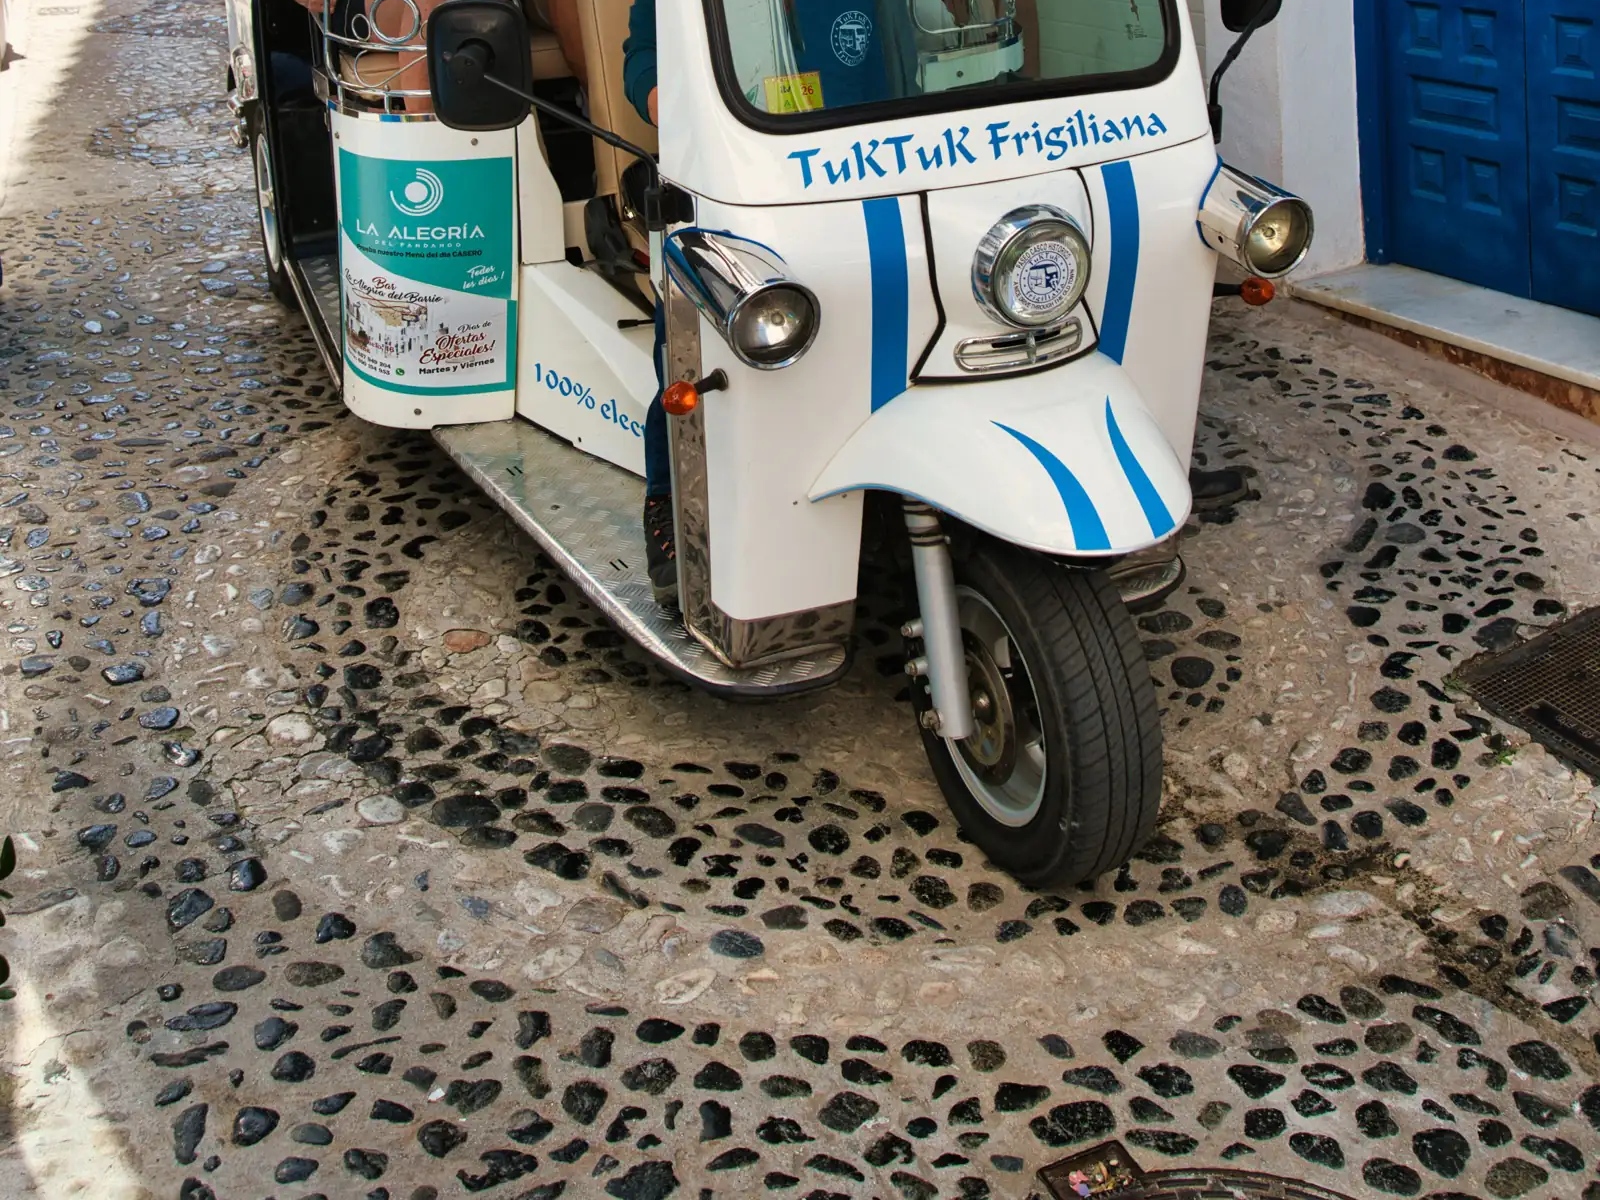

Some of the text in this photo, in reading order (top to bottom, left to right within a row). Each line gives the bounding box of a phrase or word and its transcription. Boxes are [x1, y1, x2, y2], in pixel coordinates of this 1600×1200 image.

[801, 84, 814, 96] 26
[787, 109, 1168, 189] TuKTuK Frigiliana
[356, 219, 485, 240] LA ALEGRÍA
[375, 239, 462, 249] DEL FANDANGO
[452, 249, 483, 258] CASERO
[466, 264, 496, 279] Todos
[372, 276, 397, 289] Bar
[387, 291, 404, 300] del
[404, 291, 444, 303] Barrio
[482, 320, 492, 328] de
[436, 332, 487, 350] Ofertas
[419, 340, 496, 365] Especiales!
[419, 366, 450, 375] Martes
[460, 358, 495, 369] Viernes
[534, 362, 596, 410] 100%
